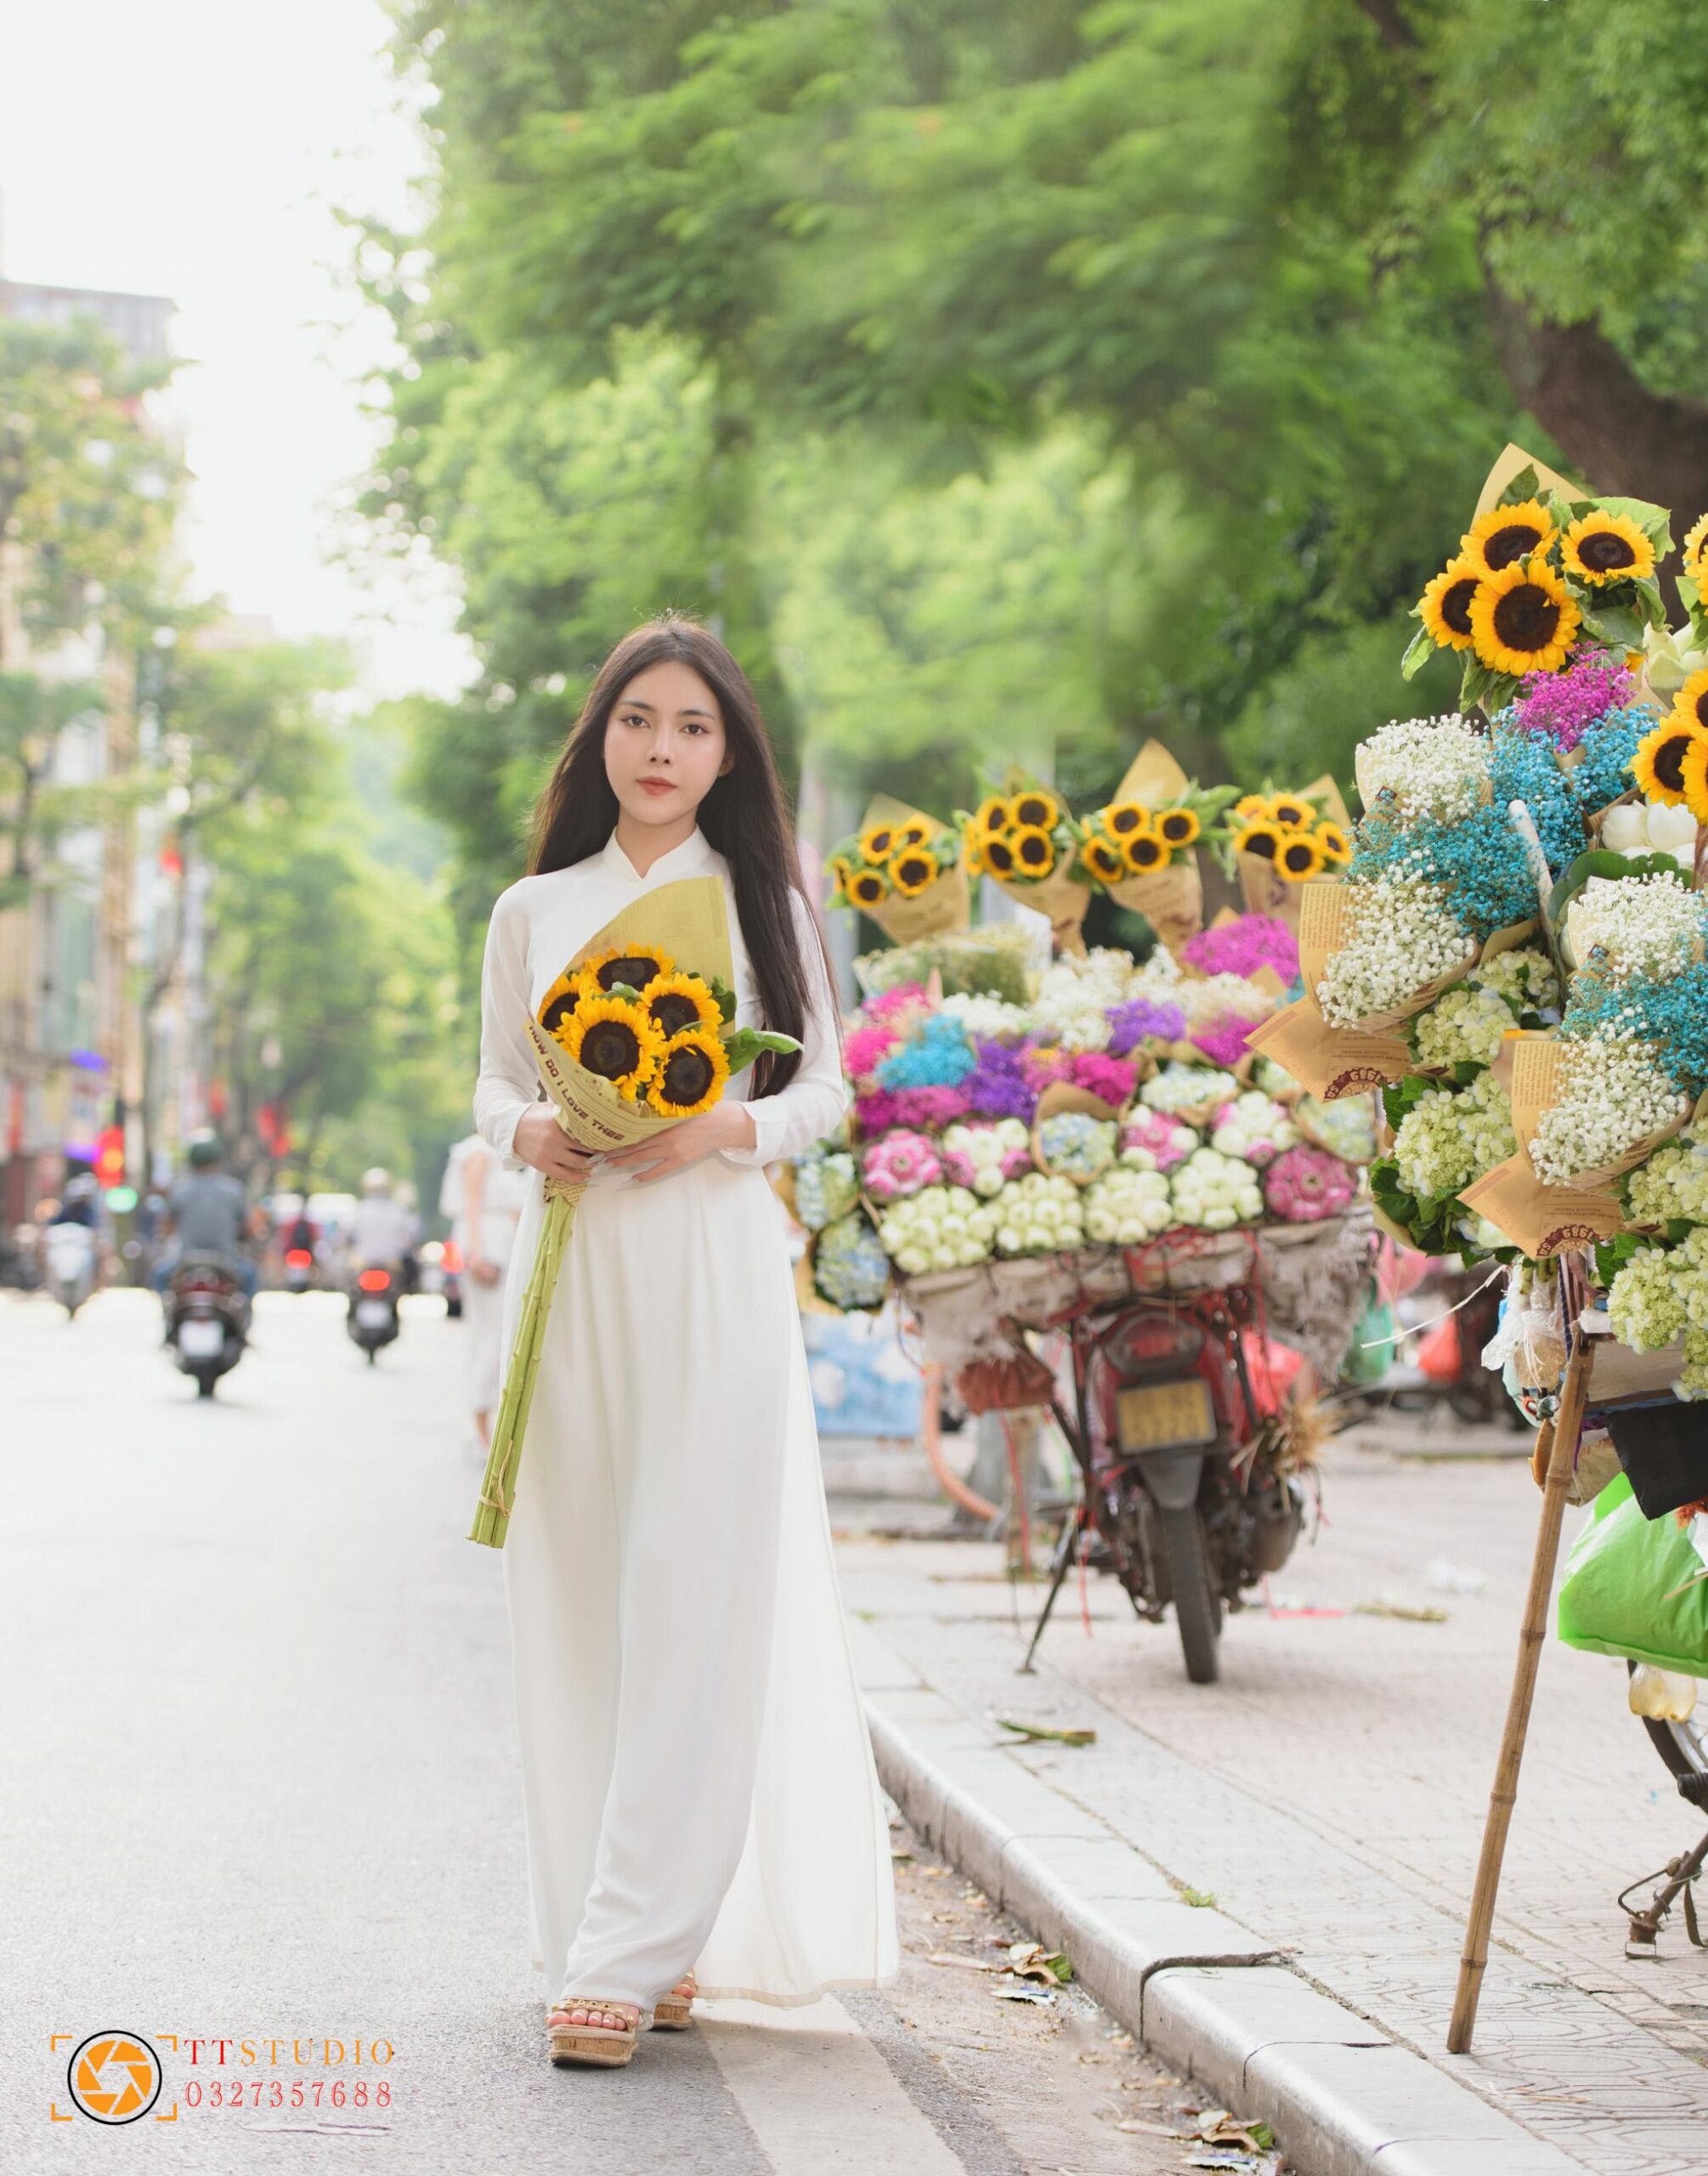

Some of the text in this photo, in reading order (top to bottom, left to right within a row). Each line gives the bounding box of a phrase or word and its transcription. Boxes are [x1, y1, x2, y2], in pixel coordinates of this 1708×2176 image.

[545, 1058, 559, 1078] DO
[562, 1088, 589, 1119] LOVE
[591, 1119, 625, 1141] THEE
